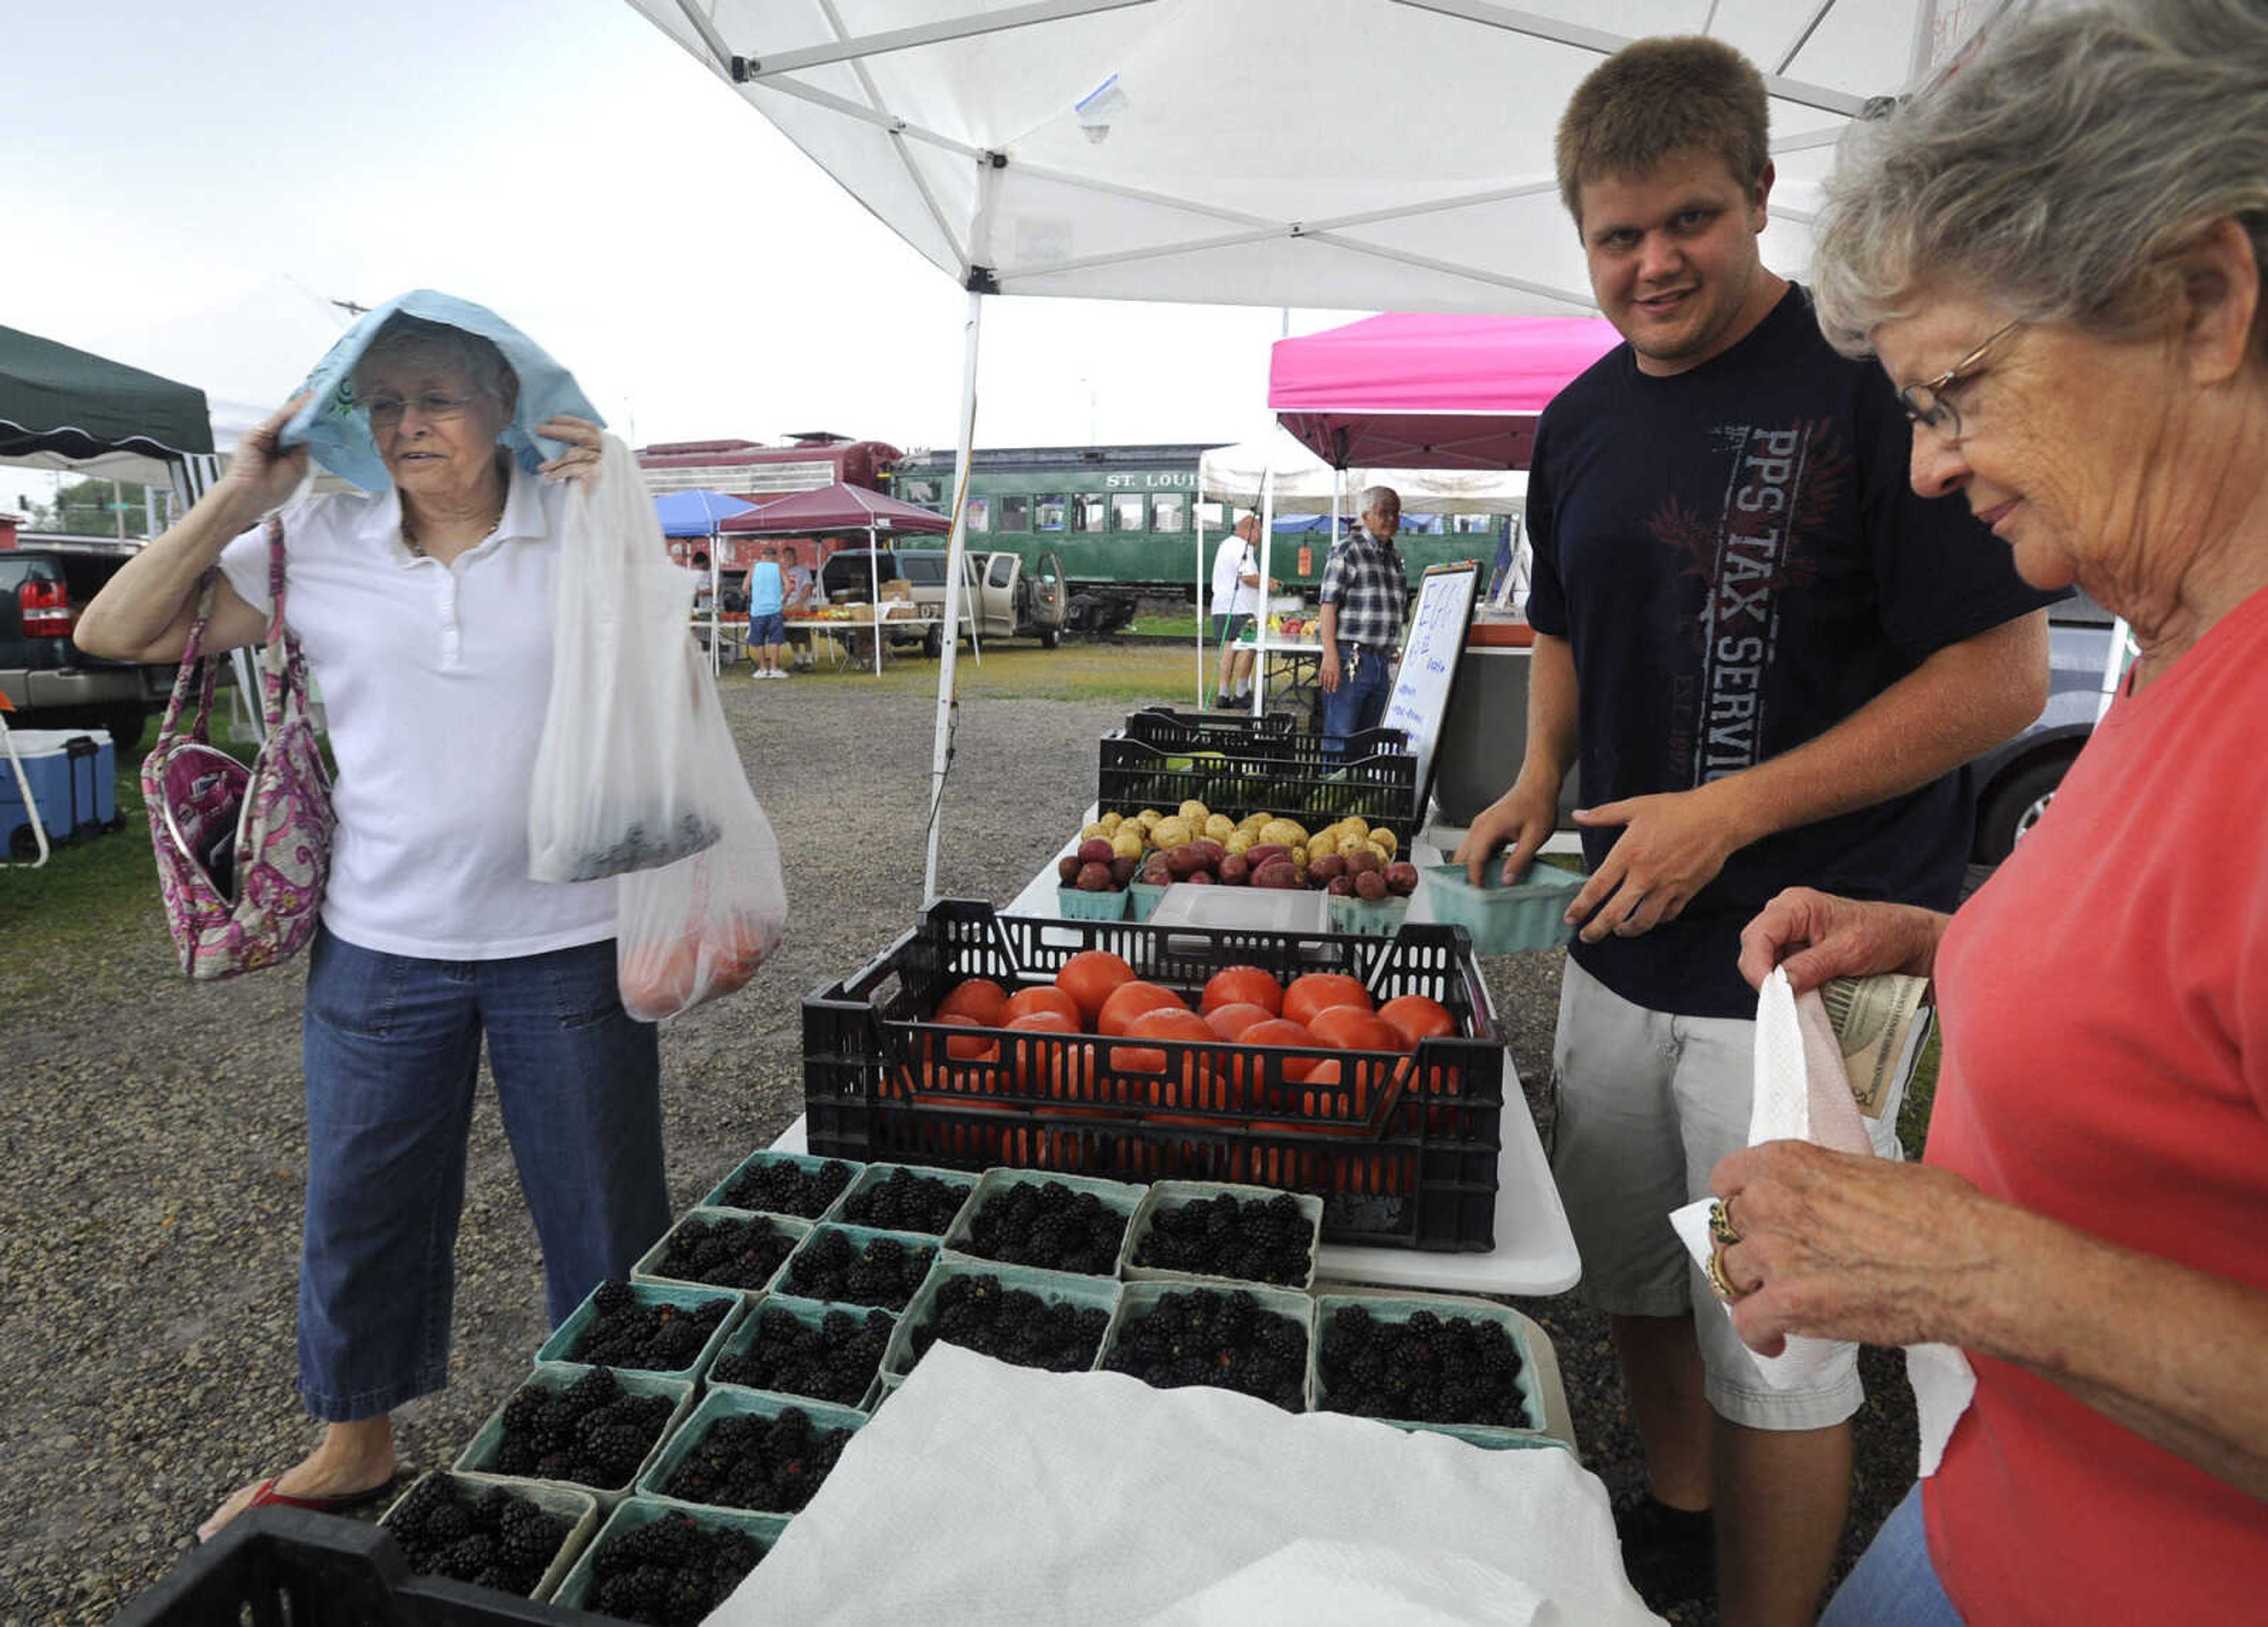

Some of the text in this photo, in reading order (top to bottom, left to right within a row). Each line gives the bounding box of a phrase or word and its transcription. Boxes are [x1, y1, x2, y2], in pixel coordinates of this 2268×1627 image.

[1106, 474, 1200, 487] ST. LOUI
[1736, 428, 1798, 514] PPS
[1720, 529, 1779, 622] TAX
